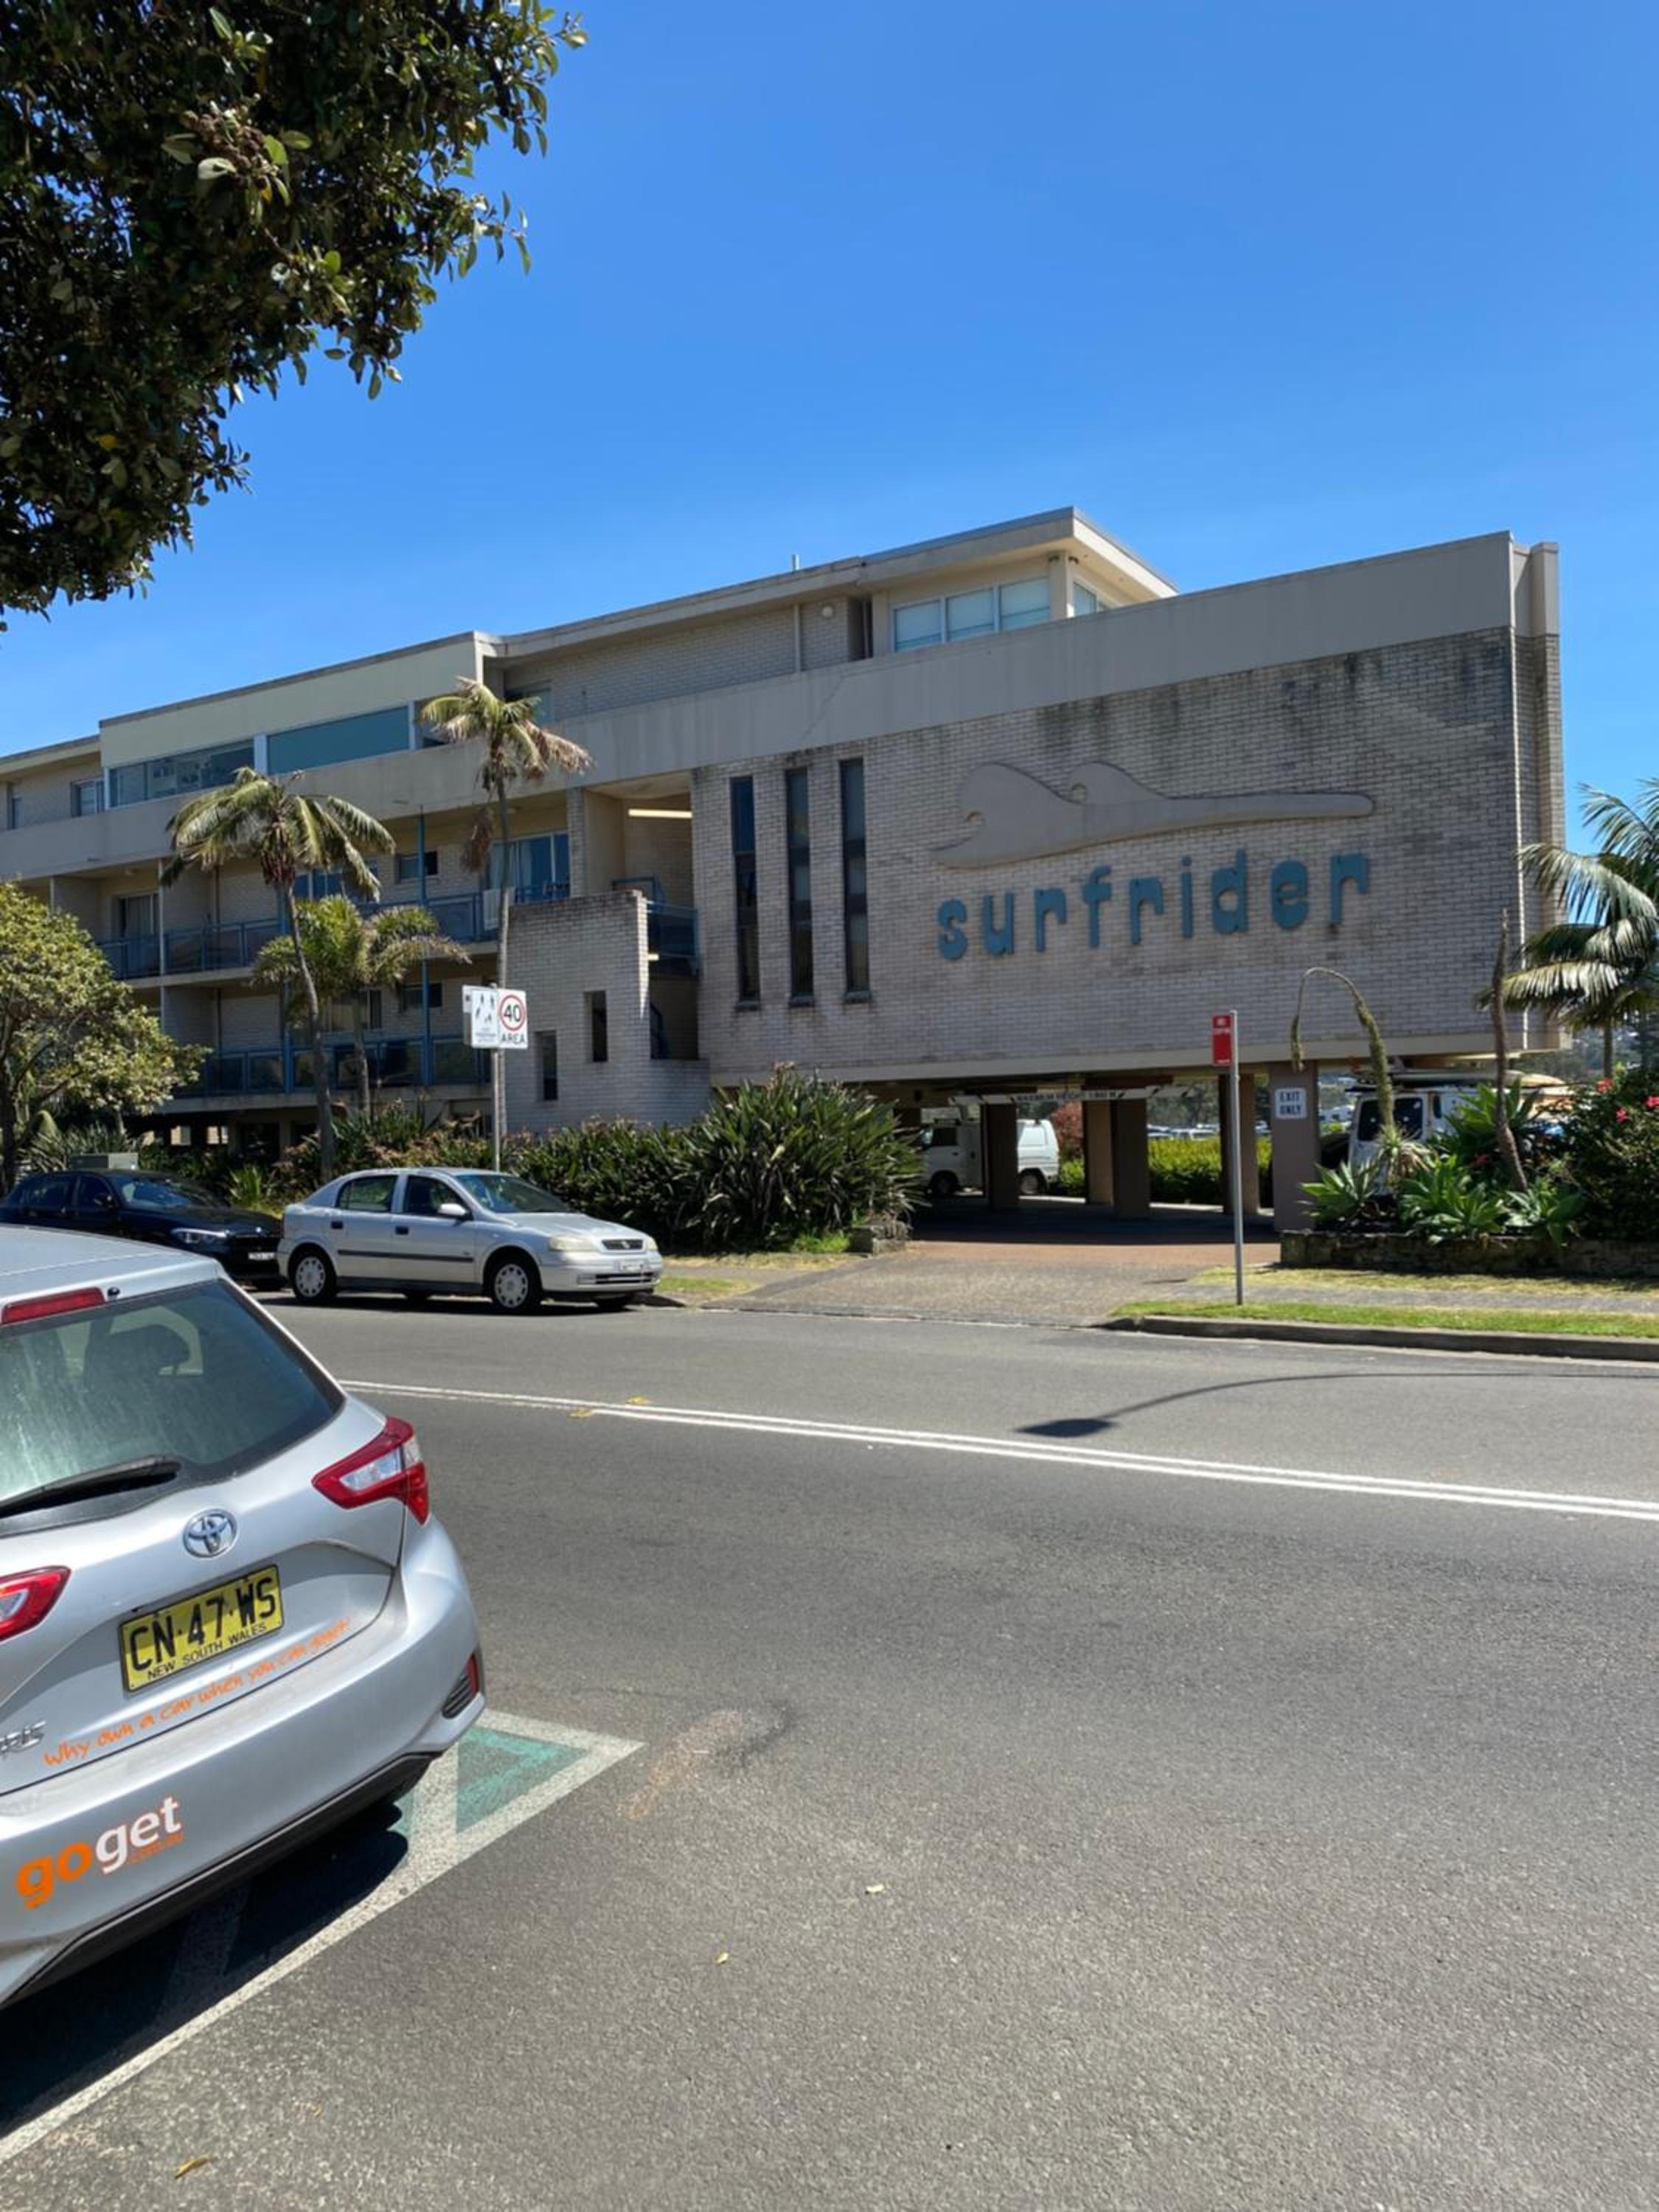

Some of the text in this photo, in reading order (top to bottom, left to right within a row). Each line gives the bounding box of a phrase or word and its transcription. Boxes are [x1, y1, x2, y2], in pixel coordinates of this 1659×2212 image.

[937, 849, 1369, 960] surfrider
[504, 1004, 521, 1022] 40
[501, 1033, 525, 1044] AREA
[1279, 1091, 1299, 1102] EXIT
[1279, 1105, 1301, 1115] ONLY
[147, 1622, 267, 1679] NEW SOUTH WALES
[43, 1742, 90, 1765] Why
[97, 1722, 133, 1745] own
[139, 1713, 156, 1729] a
[160, 1697, 192, 1719] car
[15, 1795, 182, 1910] goget
